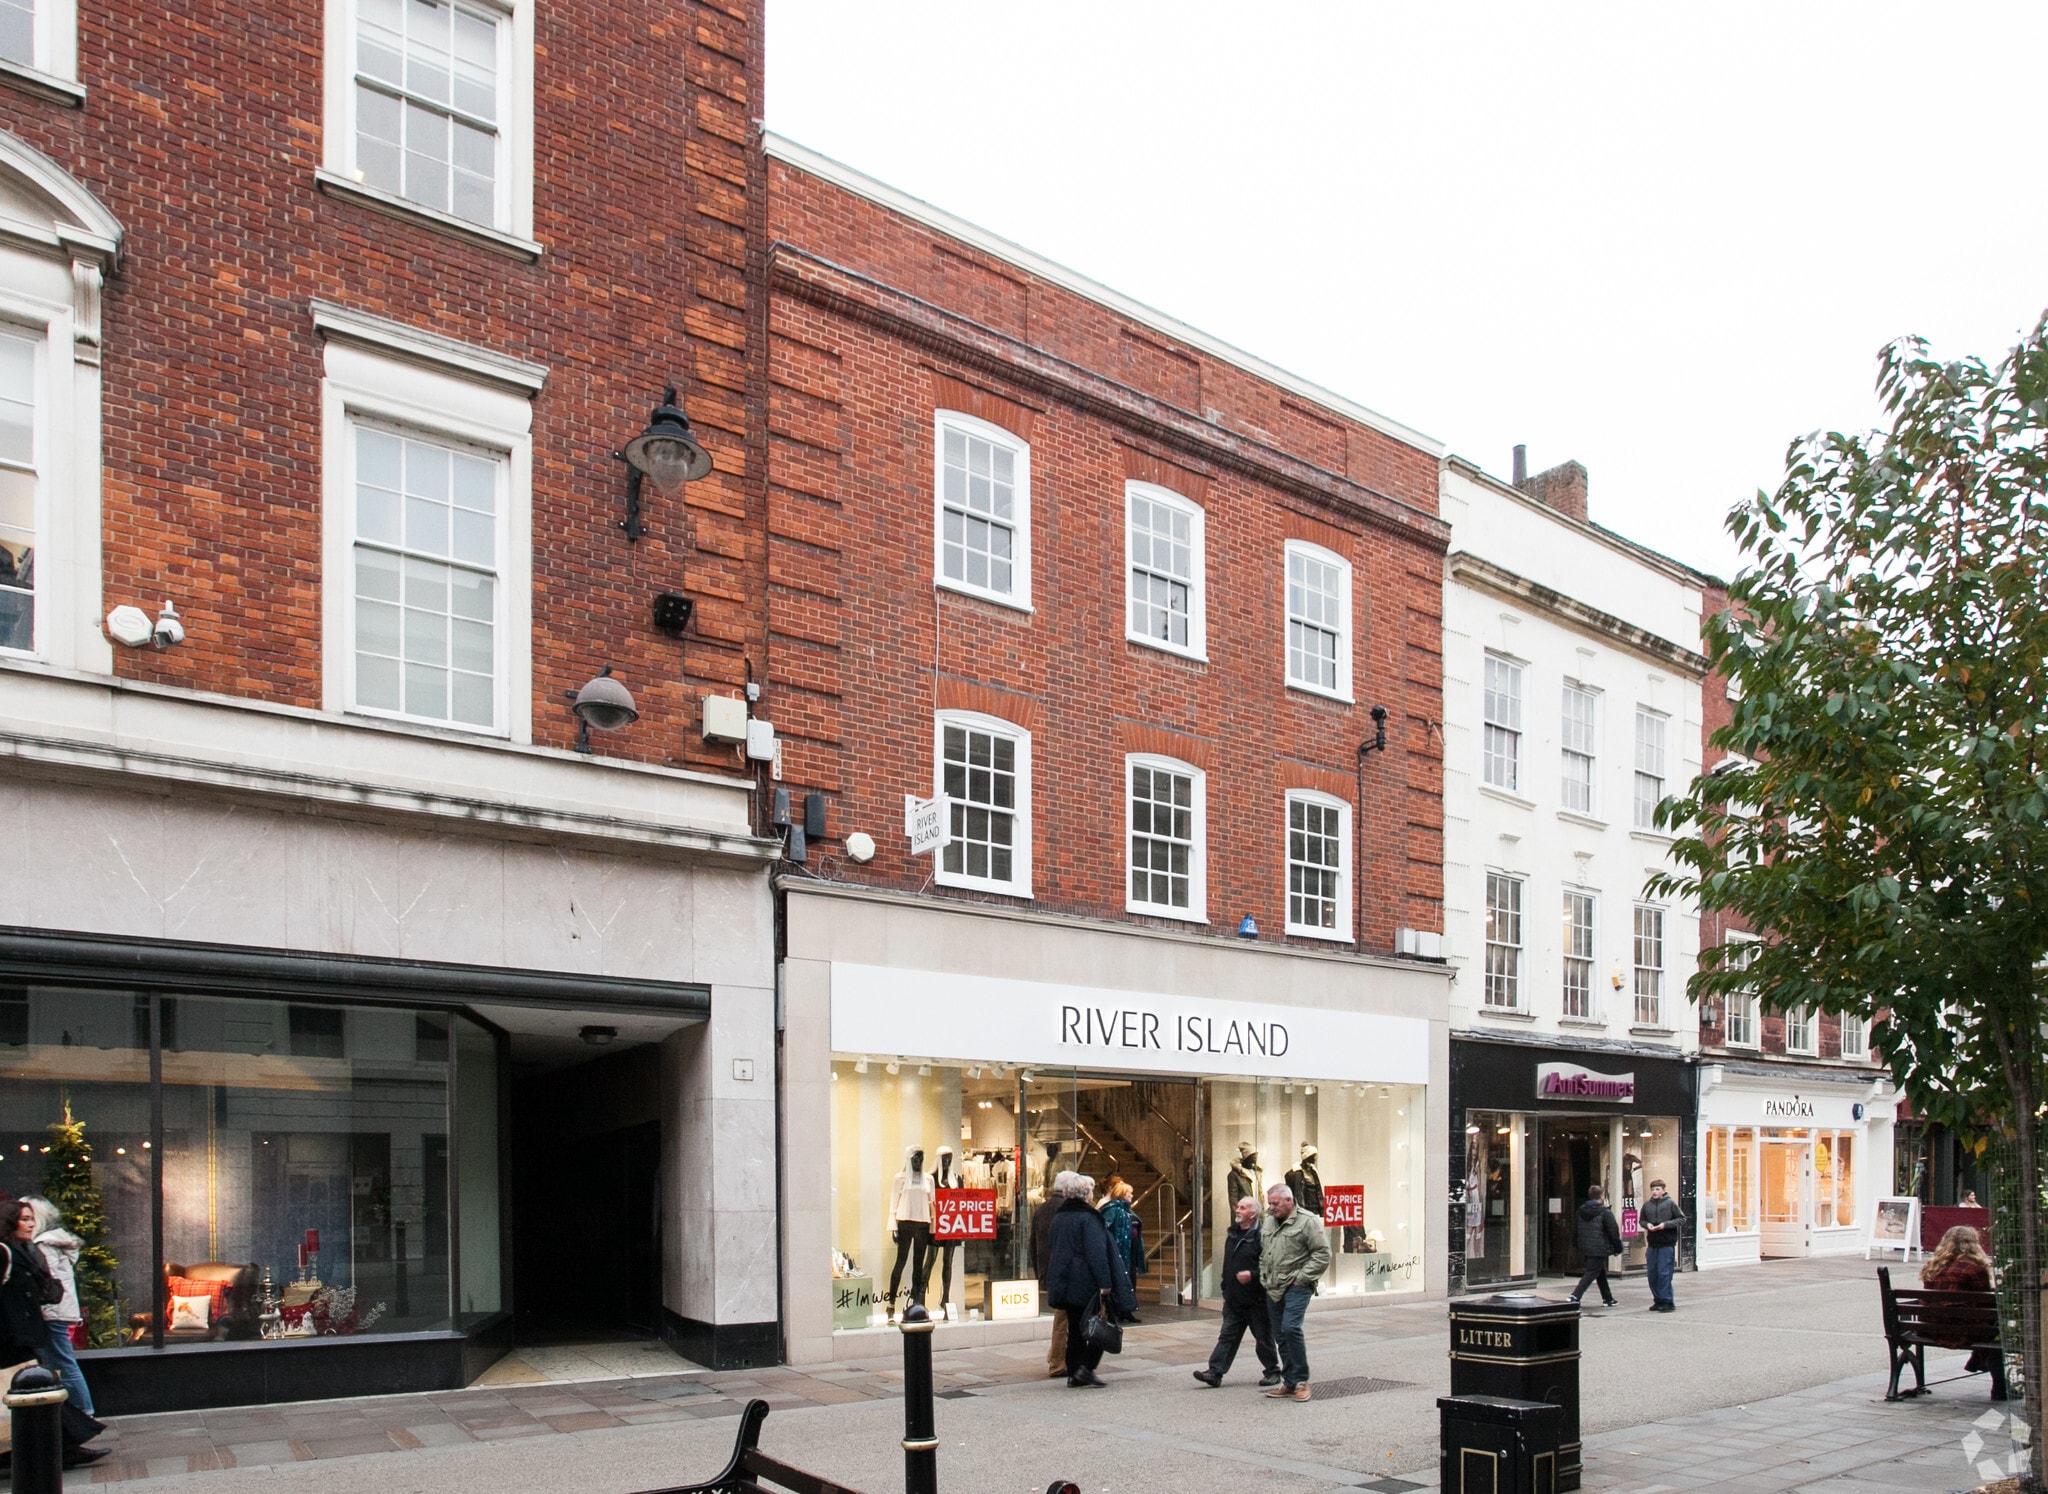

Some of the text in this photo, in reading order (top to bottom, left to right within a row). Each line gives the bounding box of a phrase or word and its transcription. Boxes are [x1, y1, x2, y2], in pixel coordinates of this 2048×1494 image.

[917, 812, 937, 830] RIVER
[914, 826, 940, 846] ISLAND
[1062, 1005, 1289, 1057] RIVER ISLAND
[1766, 1098, 1814, 1117] PANDORA
[938, 1200, 993, 1213] 1/2 PRICE
[1325, 1194, 1363, 1206] 1/2 PRICE
[1325, 1206, 1362, 1223] SALE
[938, 1214, 993, 1234] SALE
[1624, 1218, 1636, 1233] £15
[1001, 1293, 1030, 1305] KIDS
[1460, 1328, 1512, 1347] LITTER
